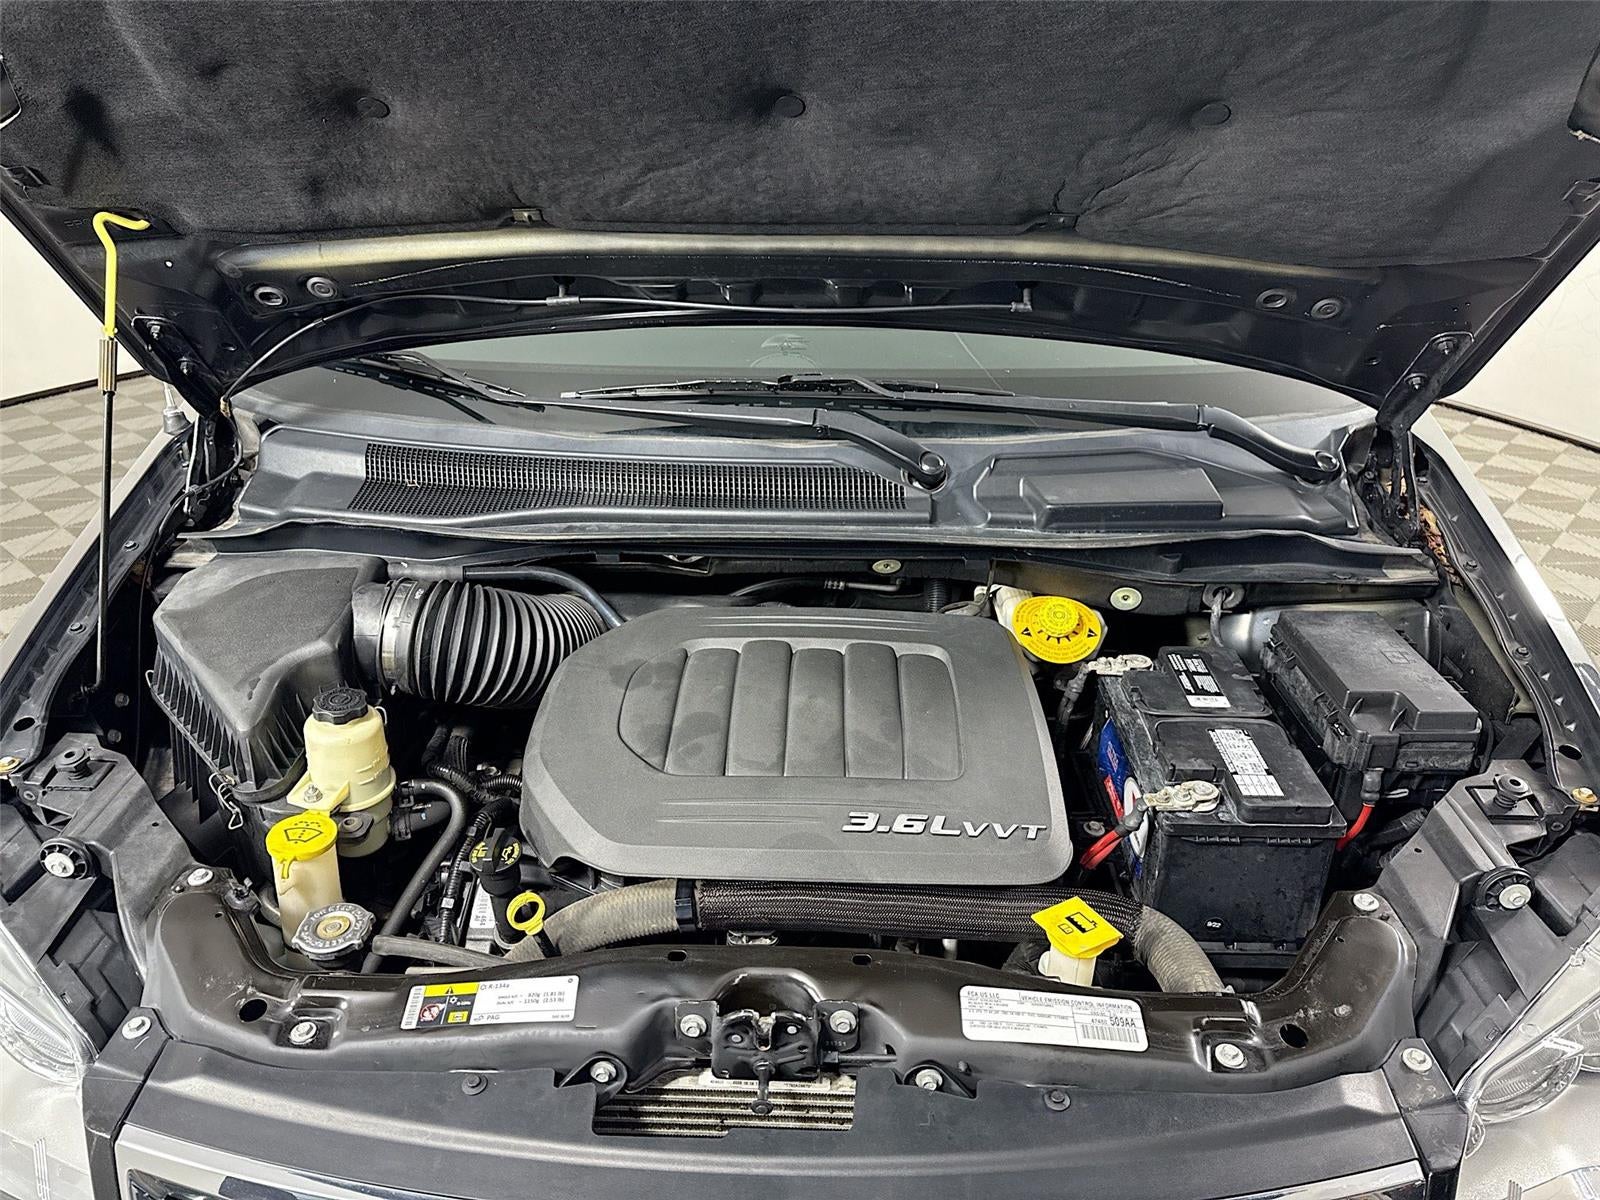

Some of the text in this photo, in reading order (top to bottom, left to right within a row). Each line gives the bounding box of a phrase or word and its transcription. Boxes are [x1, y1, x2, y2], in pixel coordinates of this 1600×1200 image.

[962, 821, 1047, 840] VVT
[1021, 994, 1043, 1003] VEHICLE
[1043, 997, 1070, 1006] EMISSION
[1070, 999, 1095, 1008] CONTROL
[1096, 1002, 1133, 1011] INFORMATION
[1109, 1016, 1137, 1028] 509AA
